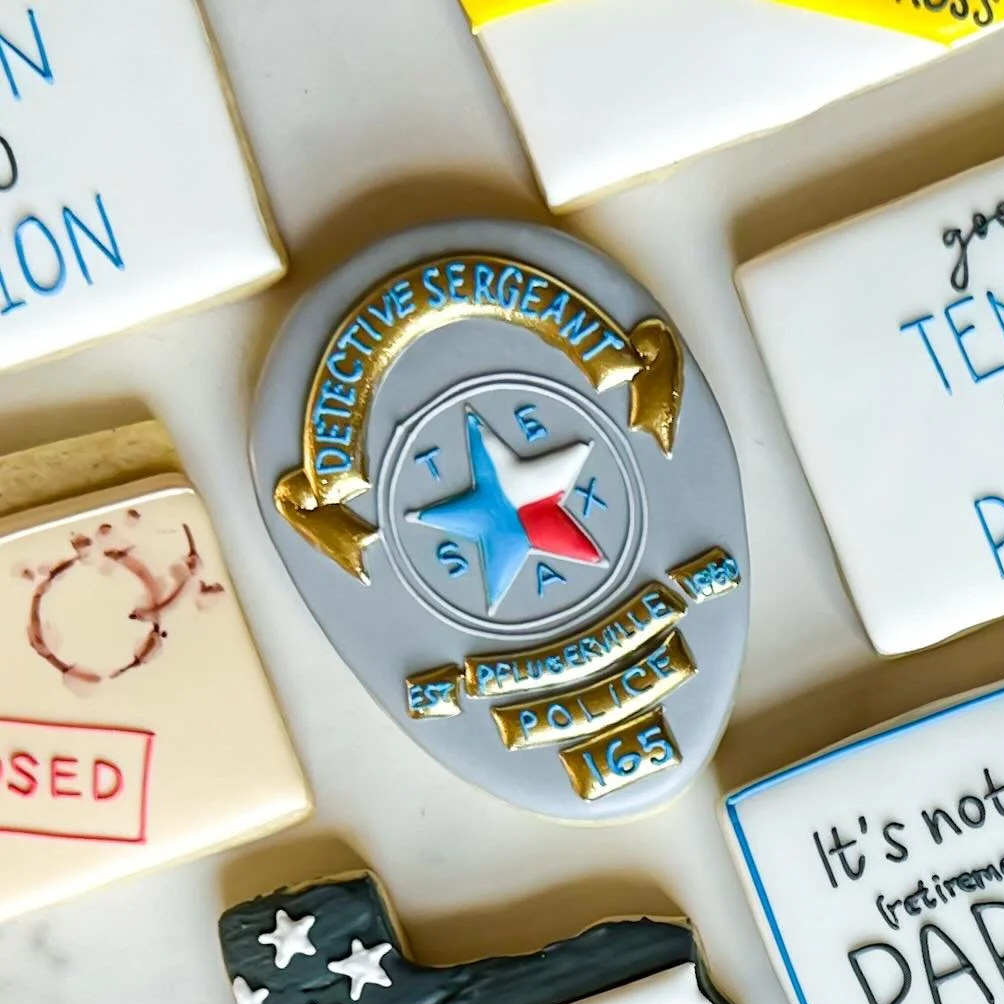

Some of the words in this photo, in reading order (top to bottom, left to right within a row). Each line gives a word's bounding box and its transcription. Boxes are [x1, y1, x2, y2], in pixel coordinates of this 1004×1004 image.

[316, 280, 414, 475] DETECTIVE
[425, 264, 625, 361] SERGEANT
[409, 682, 454, 709] EST
[477, 593, 671, 692] PFLUGERVILLE
[519, 647, 671, 739] POLICE
[583, 727, 674, 787] 165
[813, 817, 905, 887] It's
